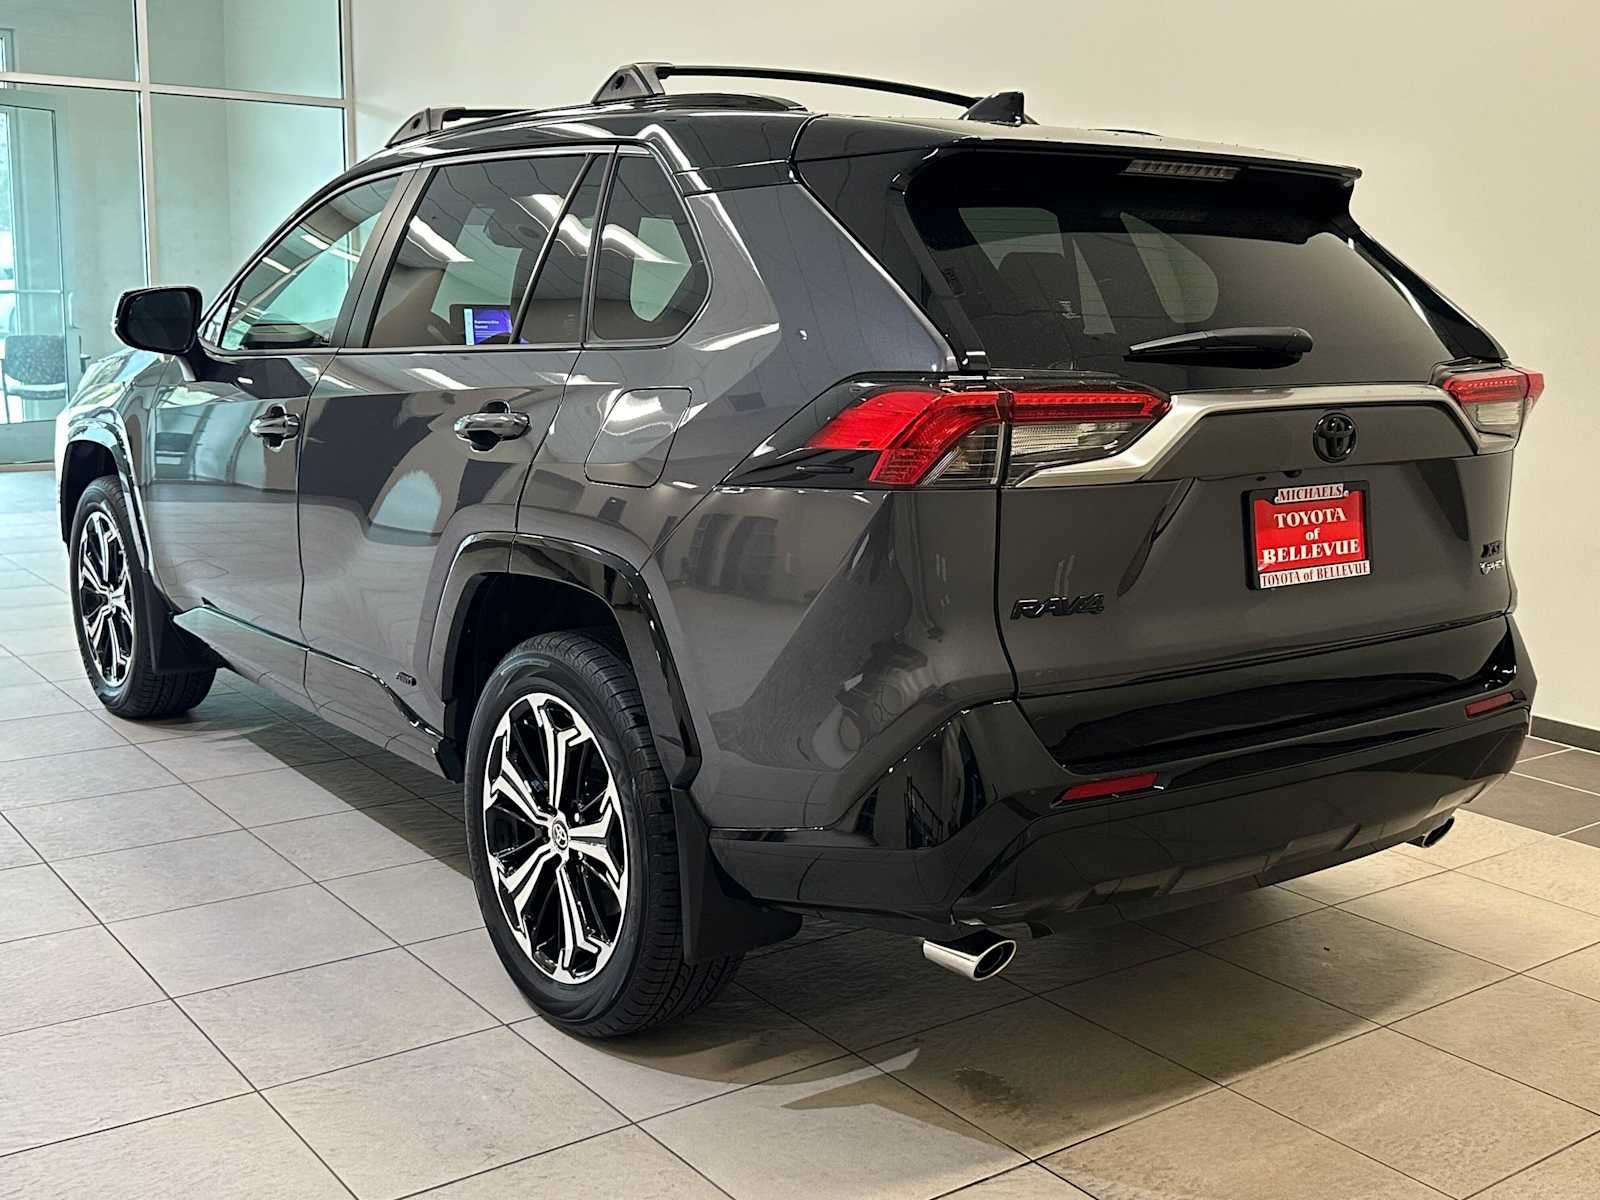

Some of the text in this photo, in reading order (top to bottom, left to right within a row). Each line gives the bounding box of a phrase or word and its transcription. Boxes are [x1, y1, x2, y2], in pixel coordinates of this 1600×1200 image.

[1279, 485, 1342, 501] MICHAELS
[1273, 507, 1347, 528] TOYOTA
[1305, 528, 1320, 541] of
[1262, 538, 1360, 565] BELLEVUE
[1262, 561, 1368, 587] TOYOTA of BELLEVUE
[1010, 594, 1105, 620] RAV4
